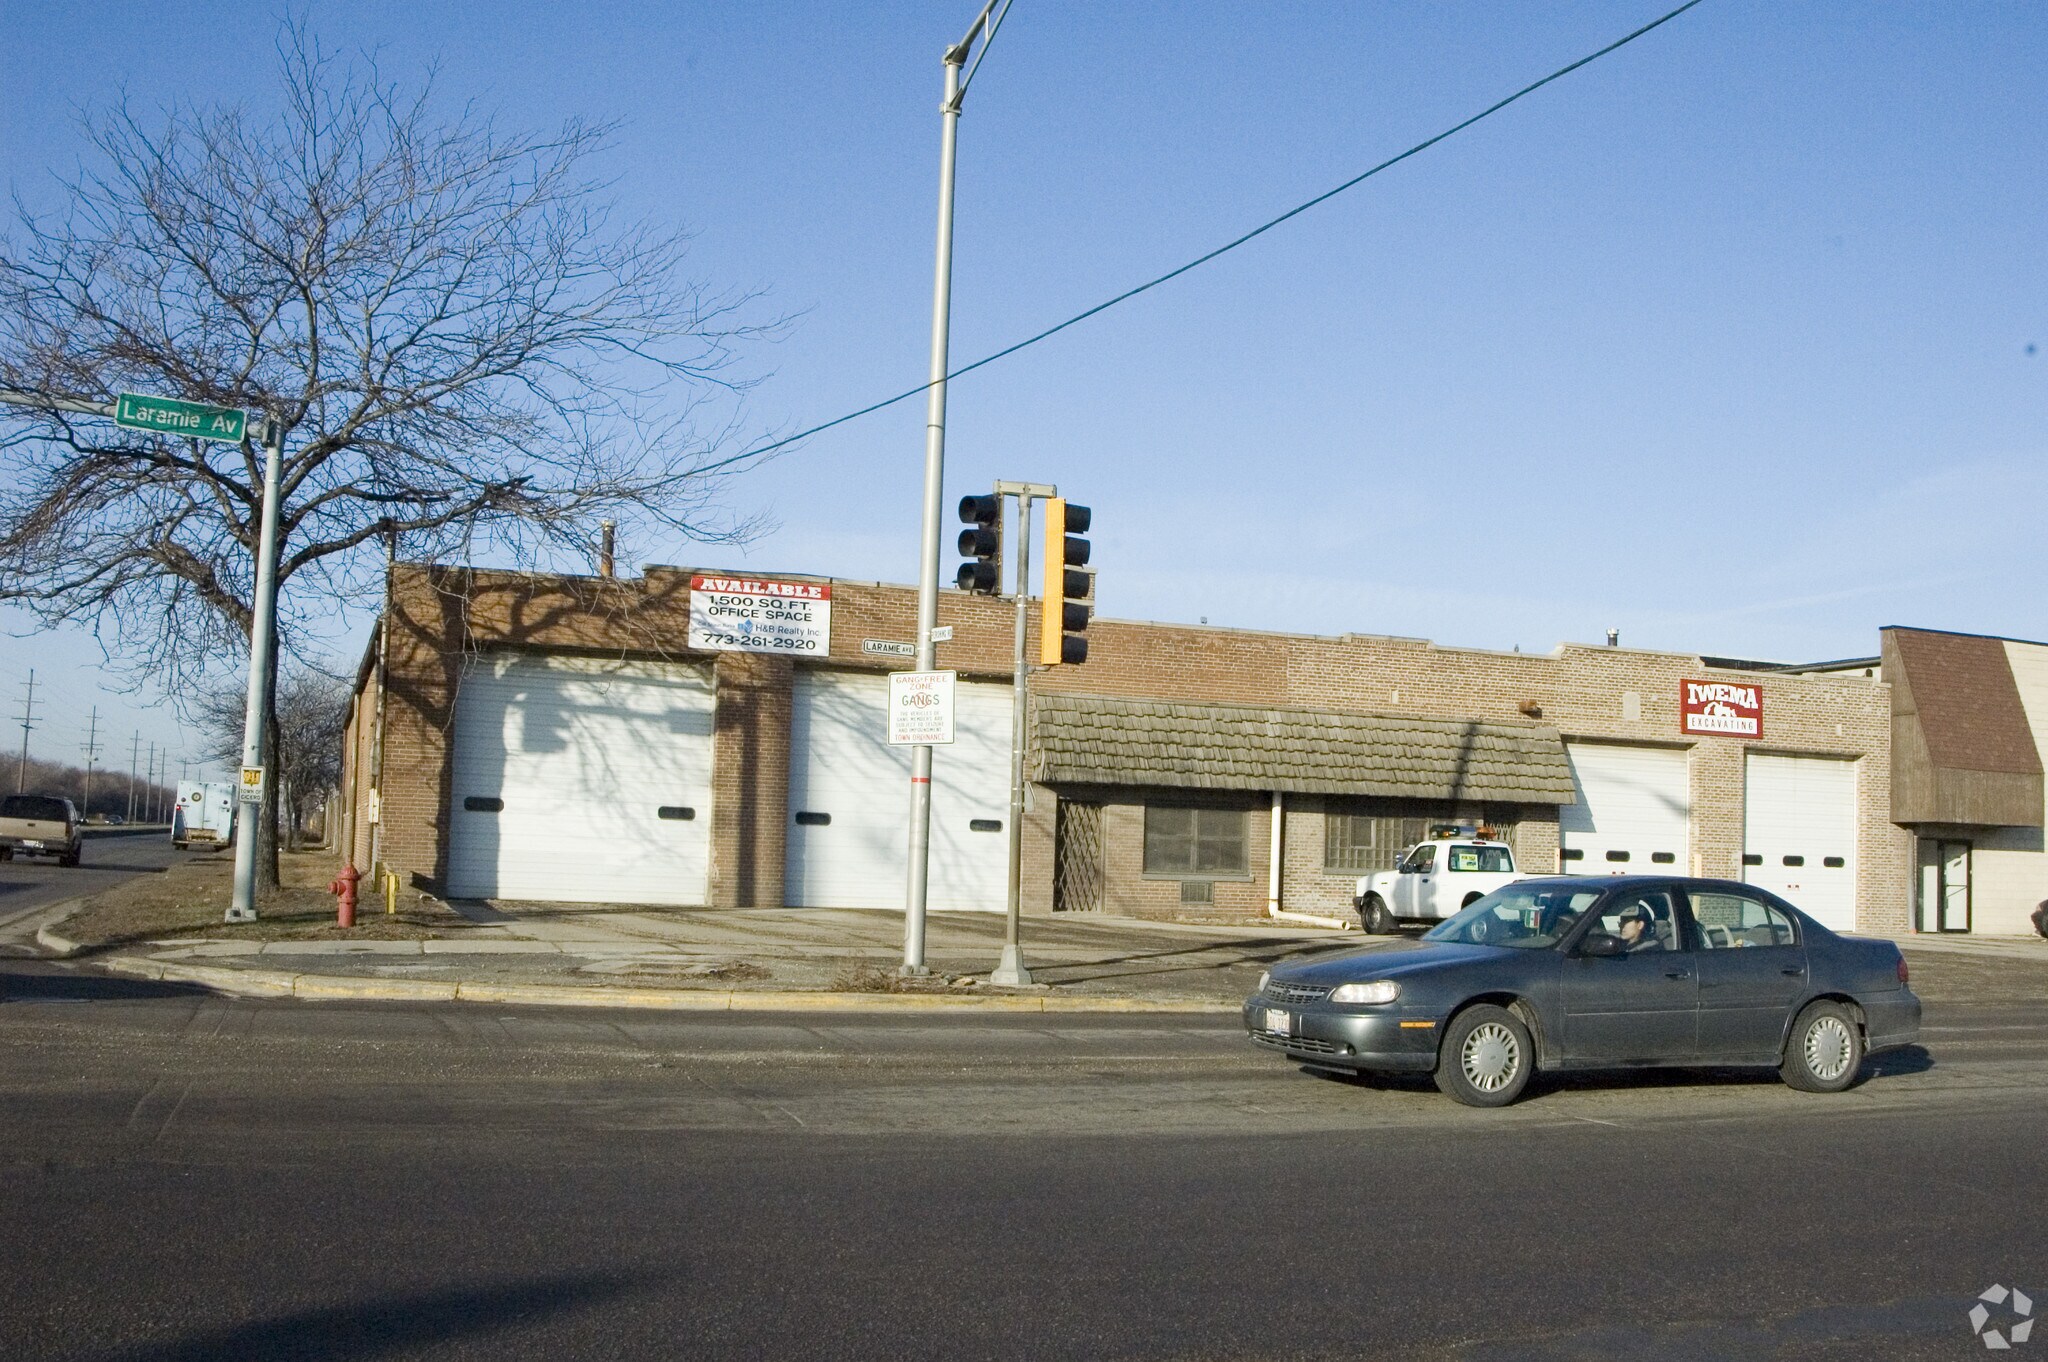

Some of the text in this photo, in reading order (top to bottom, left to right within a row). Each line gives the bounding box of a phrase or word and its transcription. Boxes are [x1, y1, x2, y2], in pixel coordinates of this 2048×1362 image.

[123, 400, 237, 433] Laramie Av
[700, 578, 822, 598] AVAILABLE
[709, 595, 754, 606] 1,500
[708, 606, 812, 622] OFFICE SPACE
[755, 624, 775, 634] H&B
[777, 625, 805, 637] Realty
[703, 633, 816, 650] 773-261-2920
[866, 641, 901, 653] LARAMIE
[902, 694, 940, 706] GANGS
[1687, 683, 1759, 709] IWEMA
[1692, 717, 1754, 731] EXCAVATING
